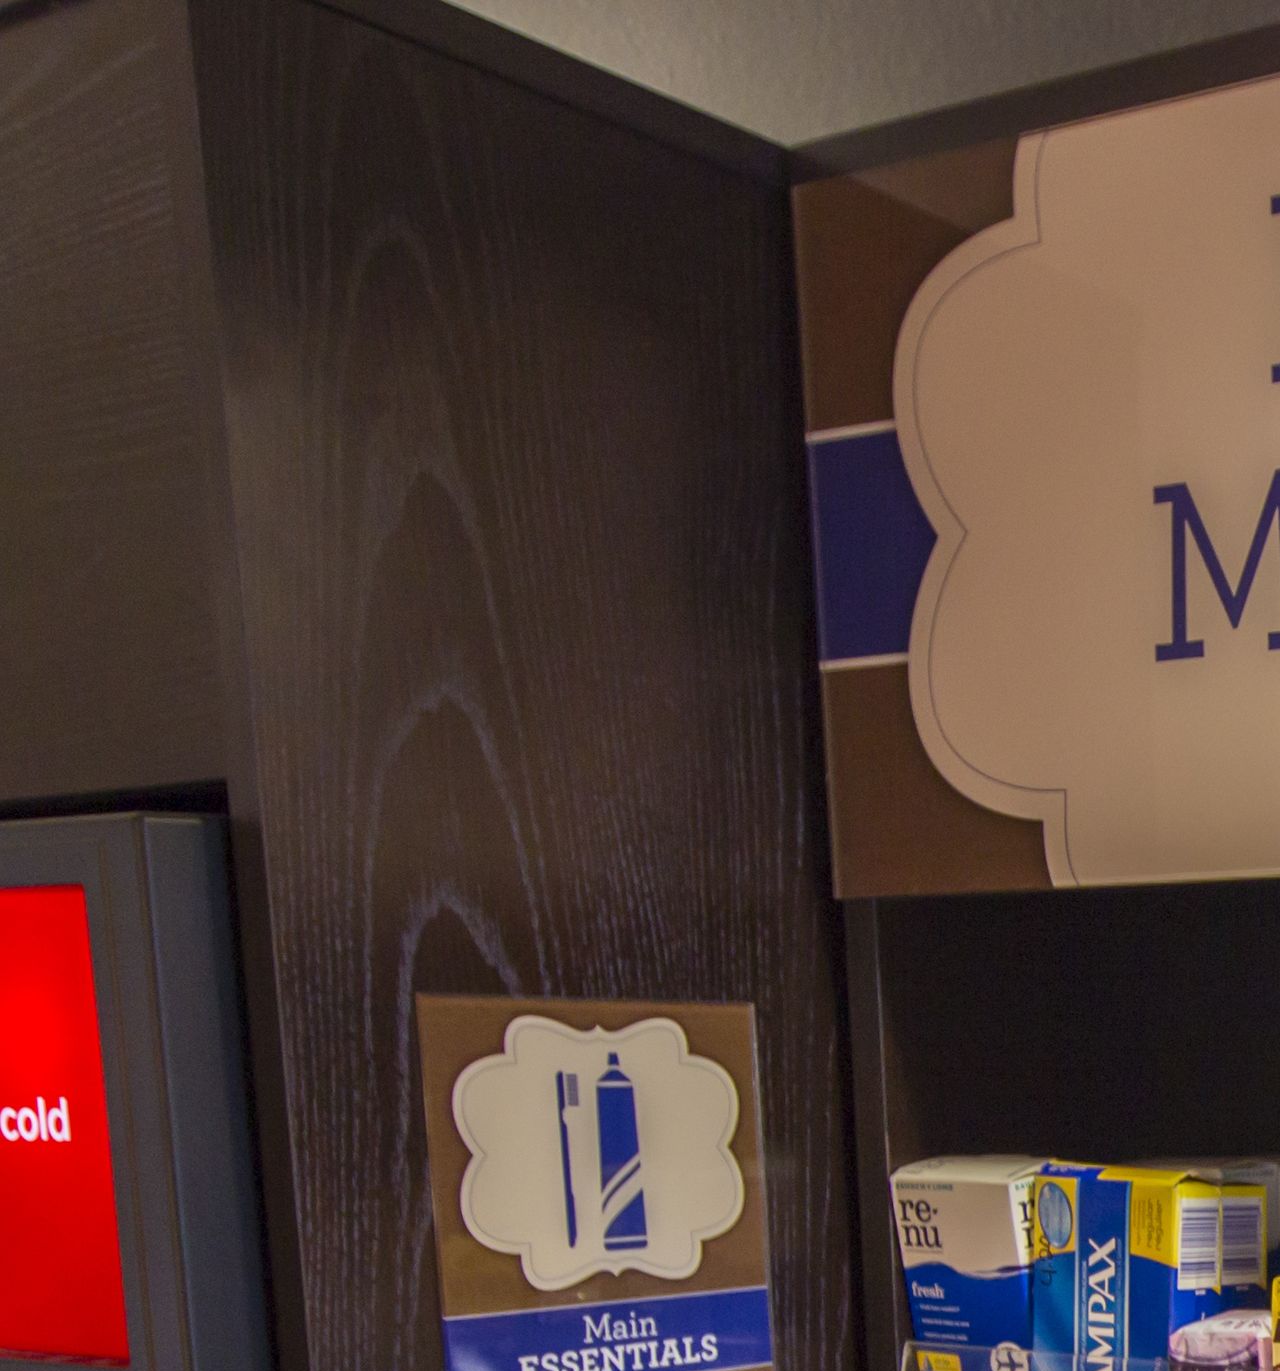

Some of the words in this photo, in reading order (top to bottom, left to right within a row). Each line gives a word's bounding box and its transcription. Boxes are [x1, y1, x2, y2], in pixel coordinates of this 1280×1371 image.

[0, 1097, 71, 1144] cold
[902, 1222, 943, 1250] nu
[911, 1280, 945, 1300] fresh
[582, 1310, 658, 1345] Main
